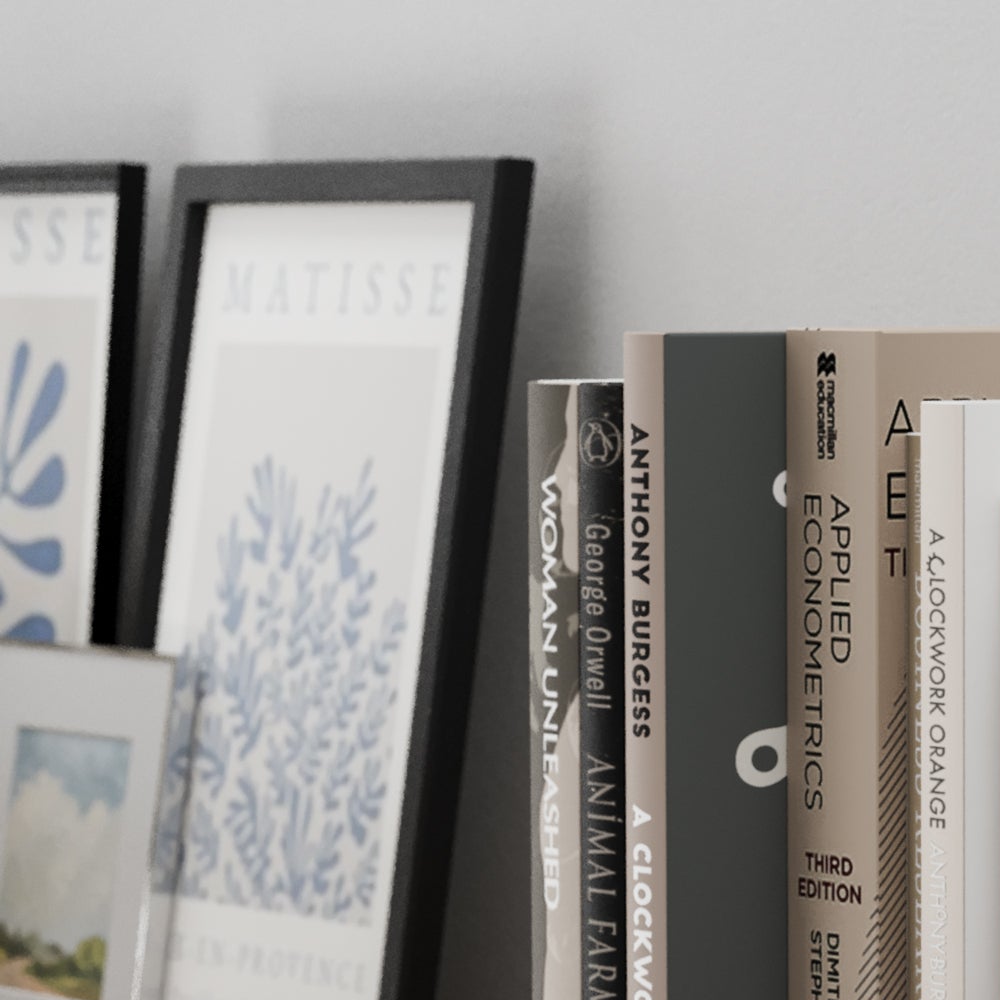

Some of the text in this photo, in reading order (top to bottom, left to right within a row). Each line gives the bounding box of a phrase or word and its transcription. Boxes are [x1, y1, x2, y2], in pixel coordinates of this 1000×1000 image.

[222, 261, 452, 317] MATISSE
[816, 379, 826, 460] education
[826, 379, 837, 460] macmillan
[581, 523, 612, 710] George Orwell
[631, 423, 651, 738] ANTHONY BURGESS
[830, 494, 851, 664] APPLIED
[541, 474, 560, 911] WOMAN UNLEASHED
[803, 494, 823, 811] ECONOMETRICS
[926, 528, 946, 830] A CLOCKWORK ORANGE
[632, 804, 652, 828] A
[805, 851, 853, 877] THIRD
[798, 877, 862, 905] EDITION
